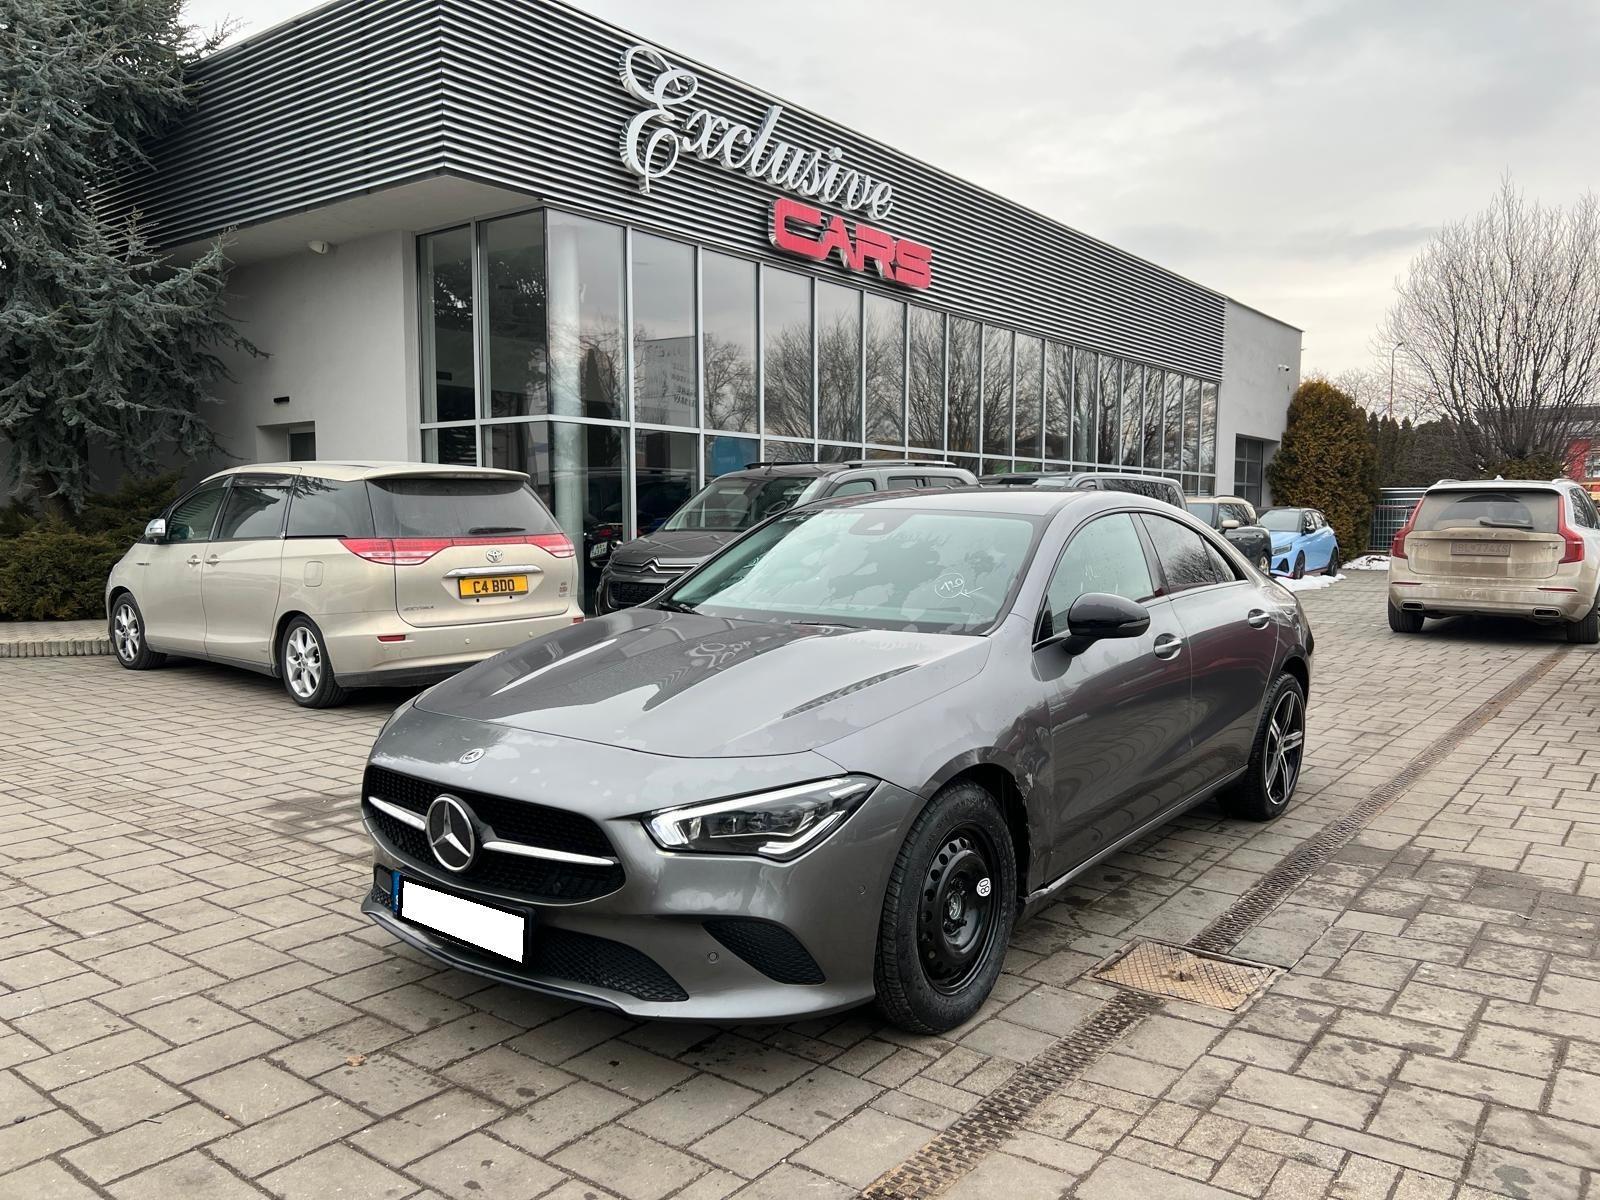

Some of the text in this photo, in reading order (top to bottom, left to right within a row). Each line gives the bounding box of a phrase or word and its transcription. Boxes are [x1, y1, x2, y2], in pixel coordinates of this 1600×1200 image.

[619, 45, 893, 220] Exclusive
[768, 198, 932, 289] CARS
[473, 579, 515, 594] C4 BDO
[979, 879, 990, 895] 80
